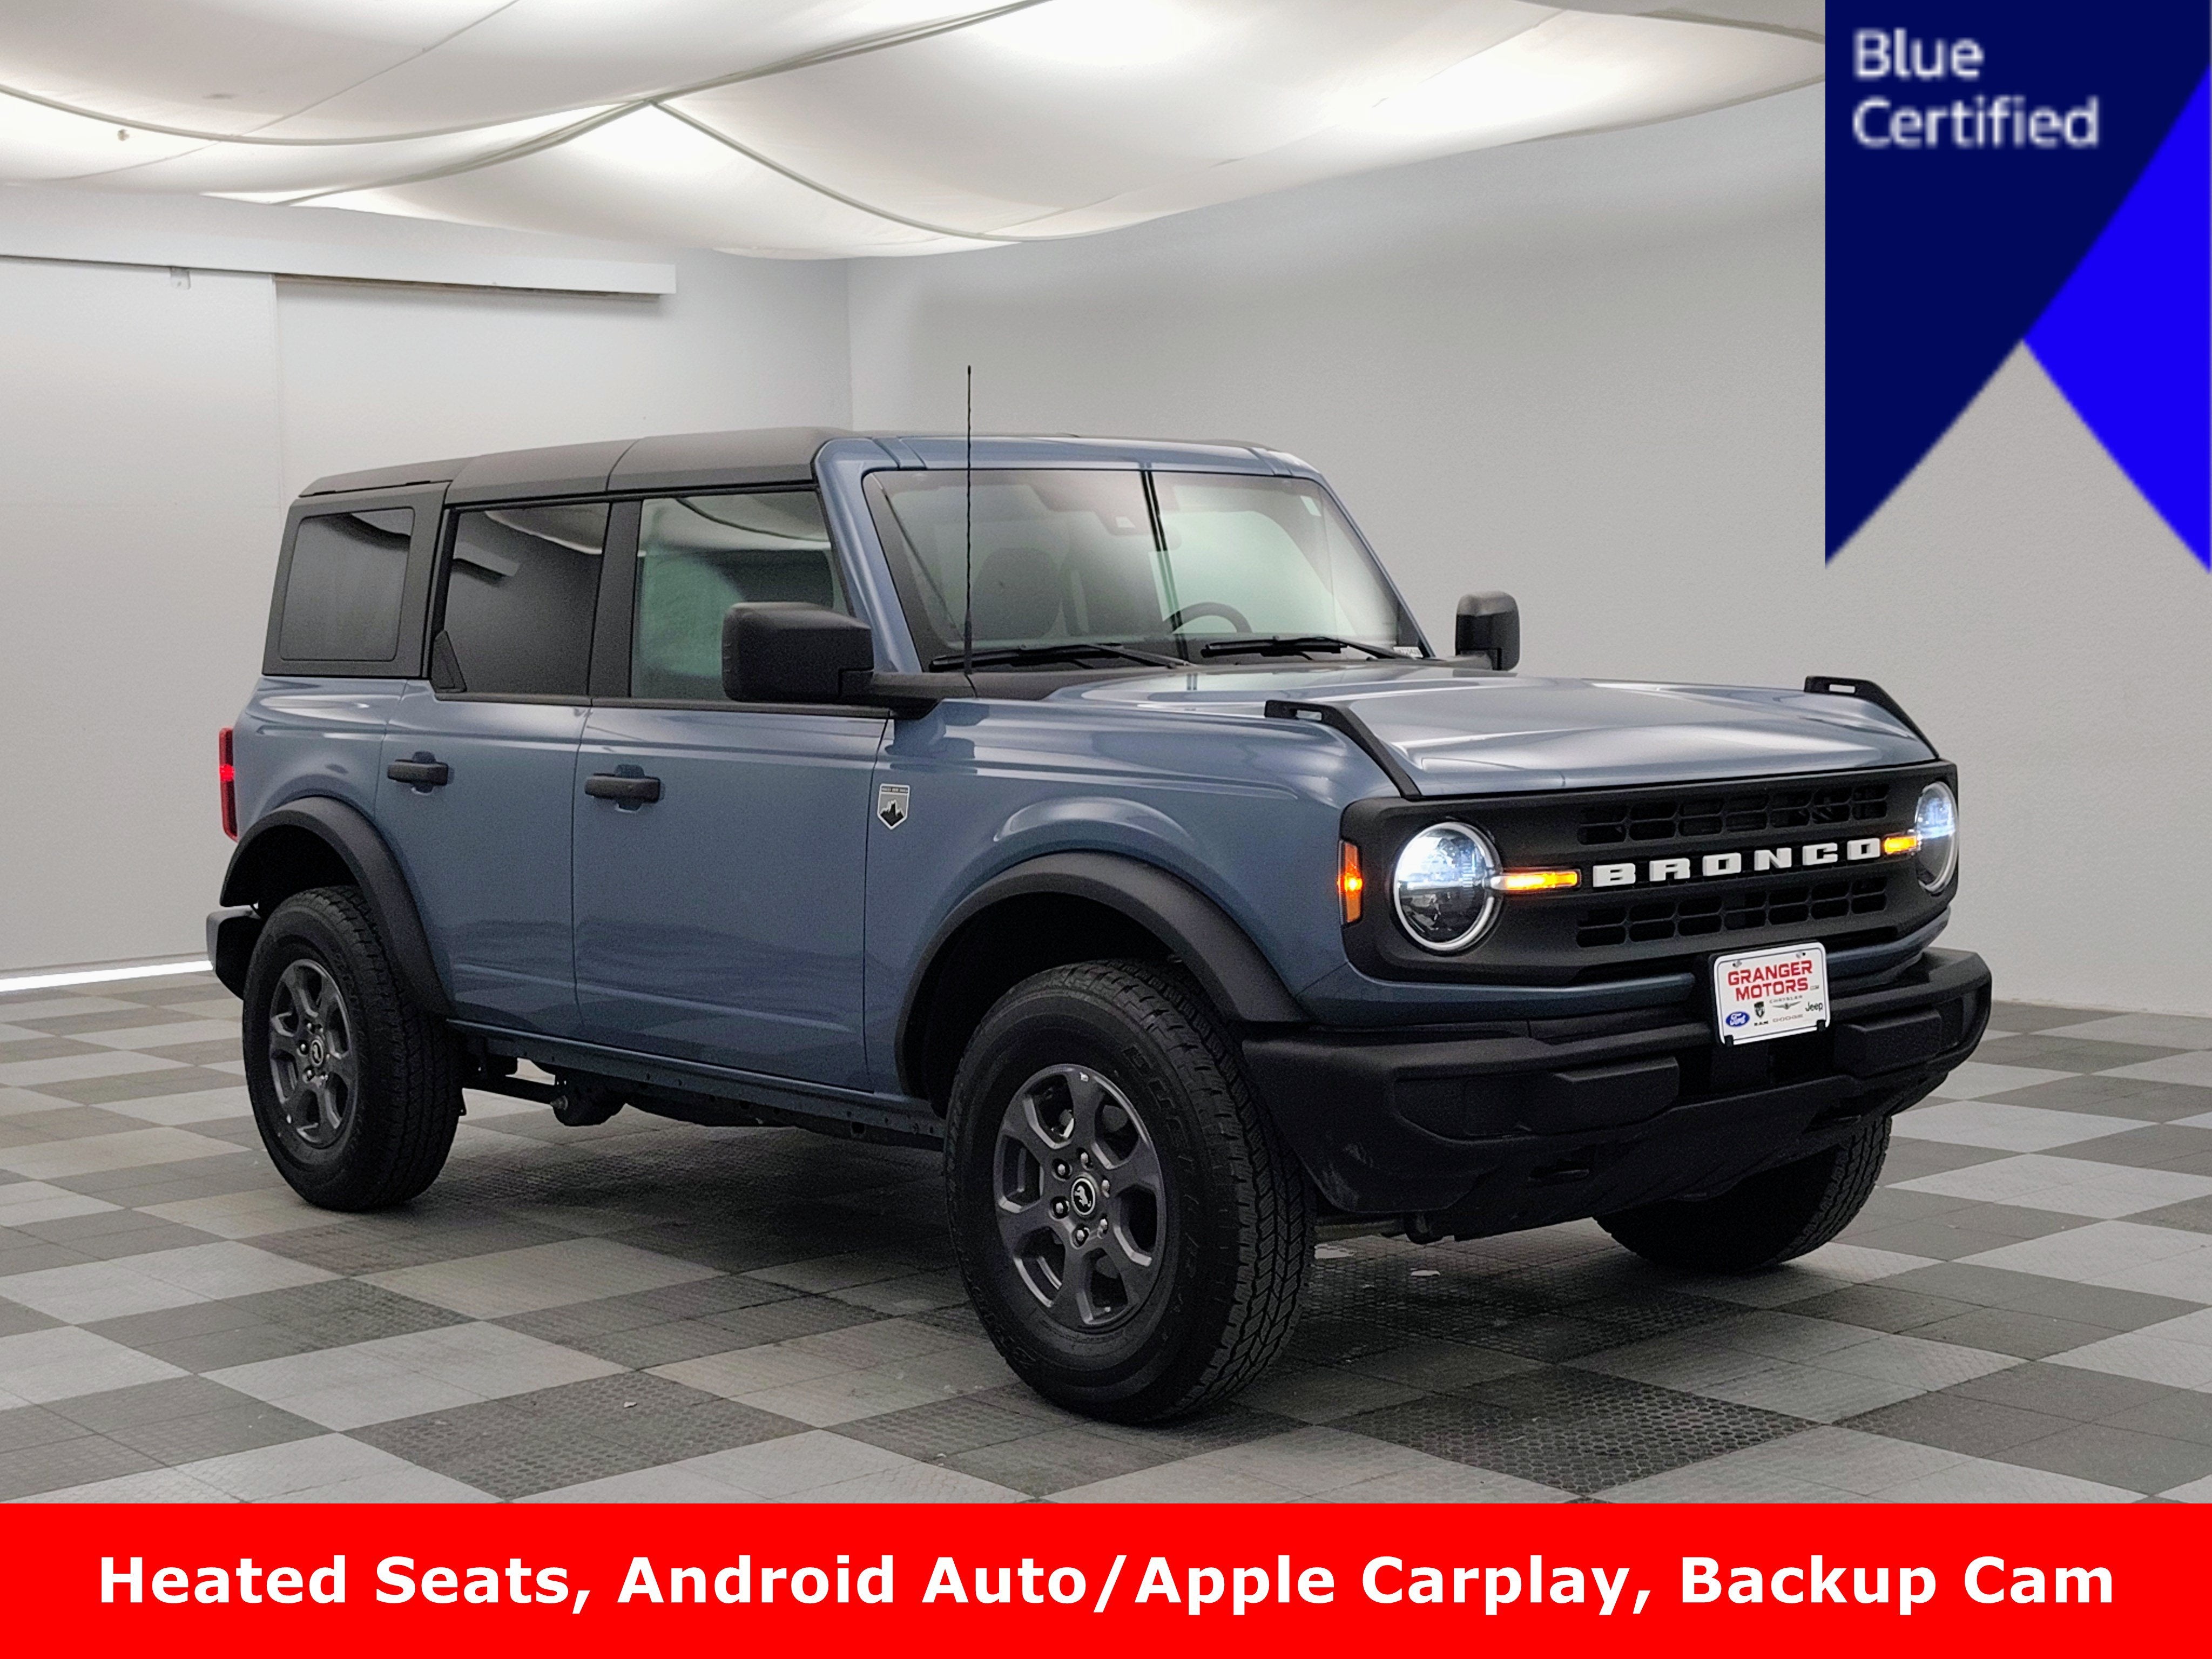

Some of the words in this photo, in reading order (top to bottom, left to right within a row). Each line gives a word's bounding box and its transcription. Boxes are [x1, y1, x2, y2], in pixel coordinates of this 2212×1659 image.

[1593, 838, 1880, 887] BRONCO
[1728, 960, 1813, 986] GRANGER
[1735, 977, 1808, 1001] MOTORS
[1805, 1001, 1823, 1011] Jeep
